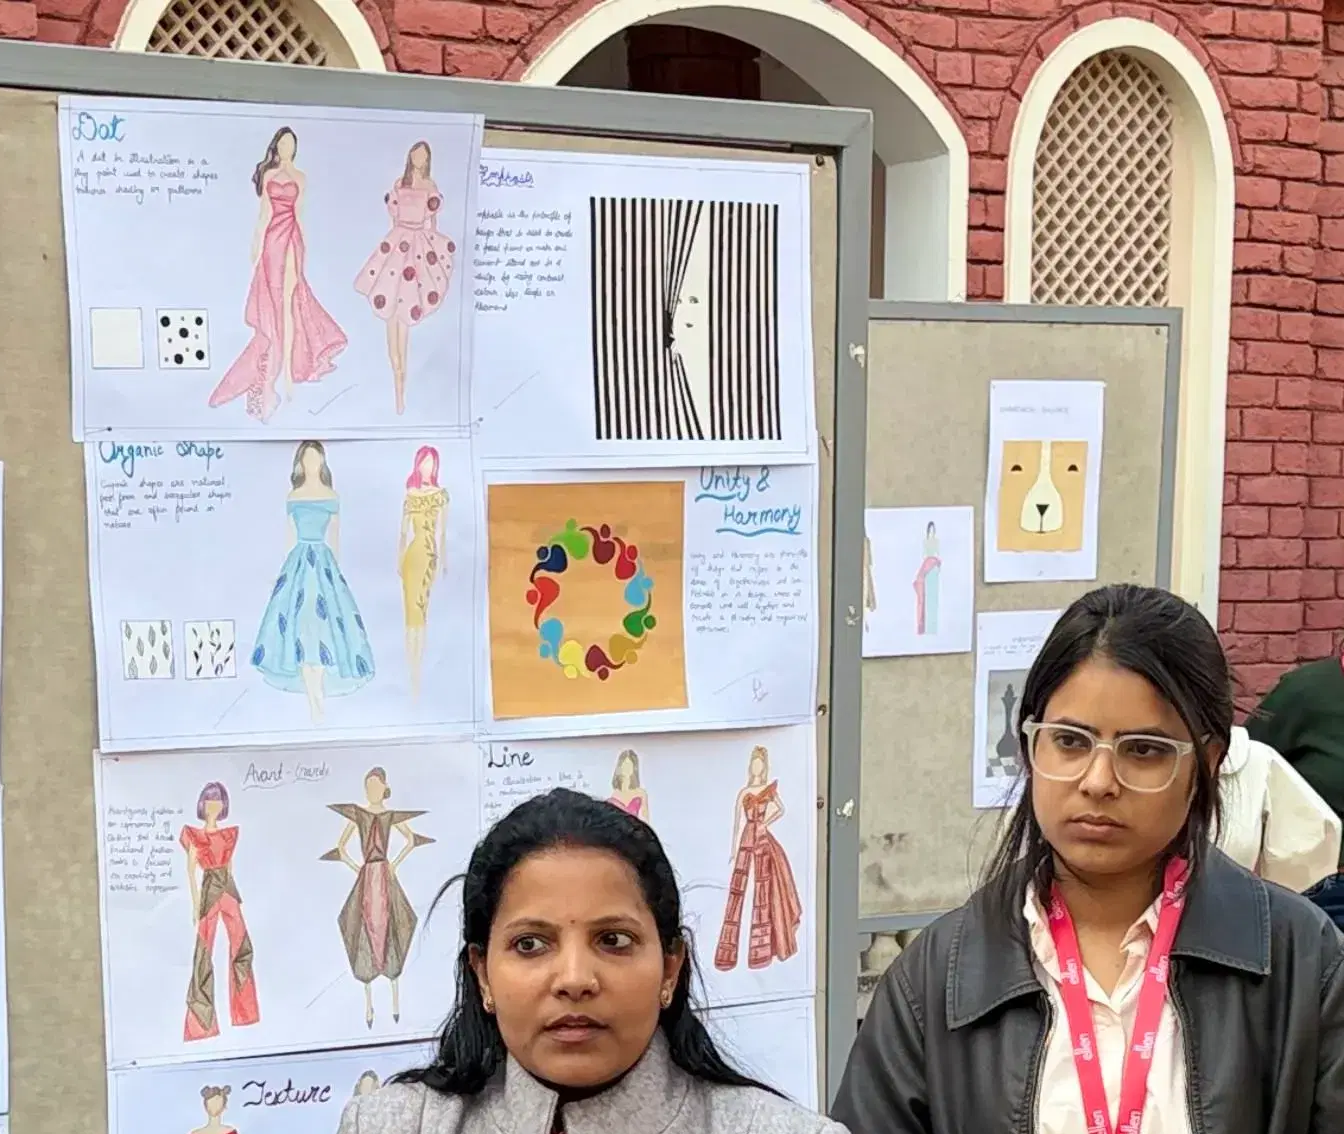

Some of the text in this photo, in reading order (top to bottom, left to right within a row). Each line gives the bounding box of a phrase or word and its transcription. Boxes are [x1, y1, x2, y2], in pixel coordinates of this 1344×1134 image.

[99, 441, 163, 478] Organic
[700, 465, 770, 501] Unity &
[724, 504, 801, 531] Harmony
[488, 744, 534, 768] Line
[242, 1079, 331, 1107] Texture
